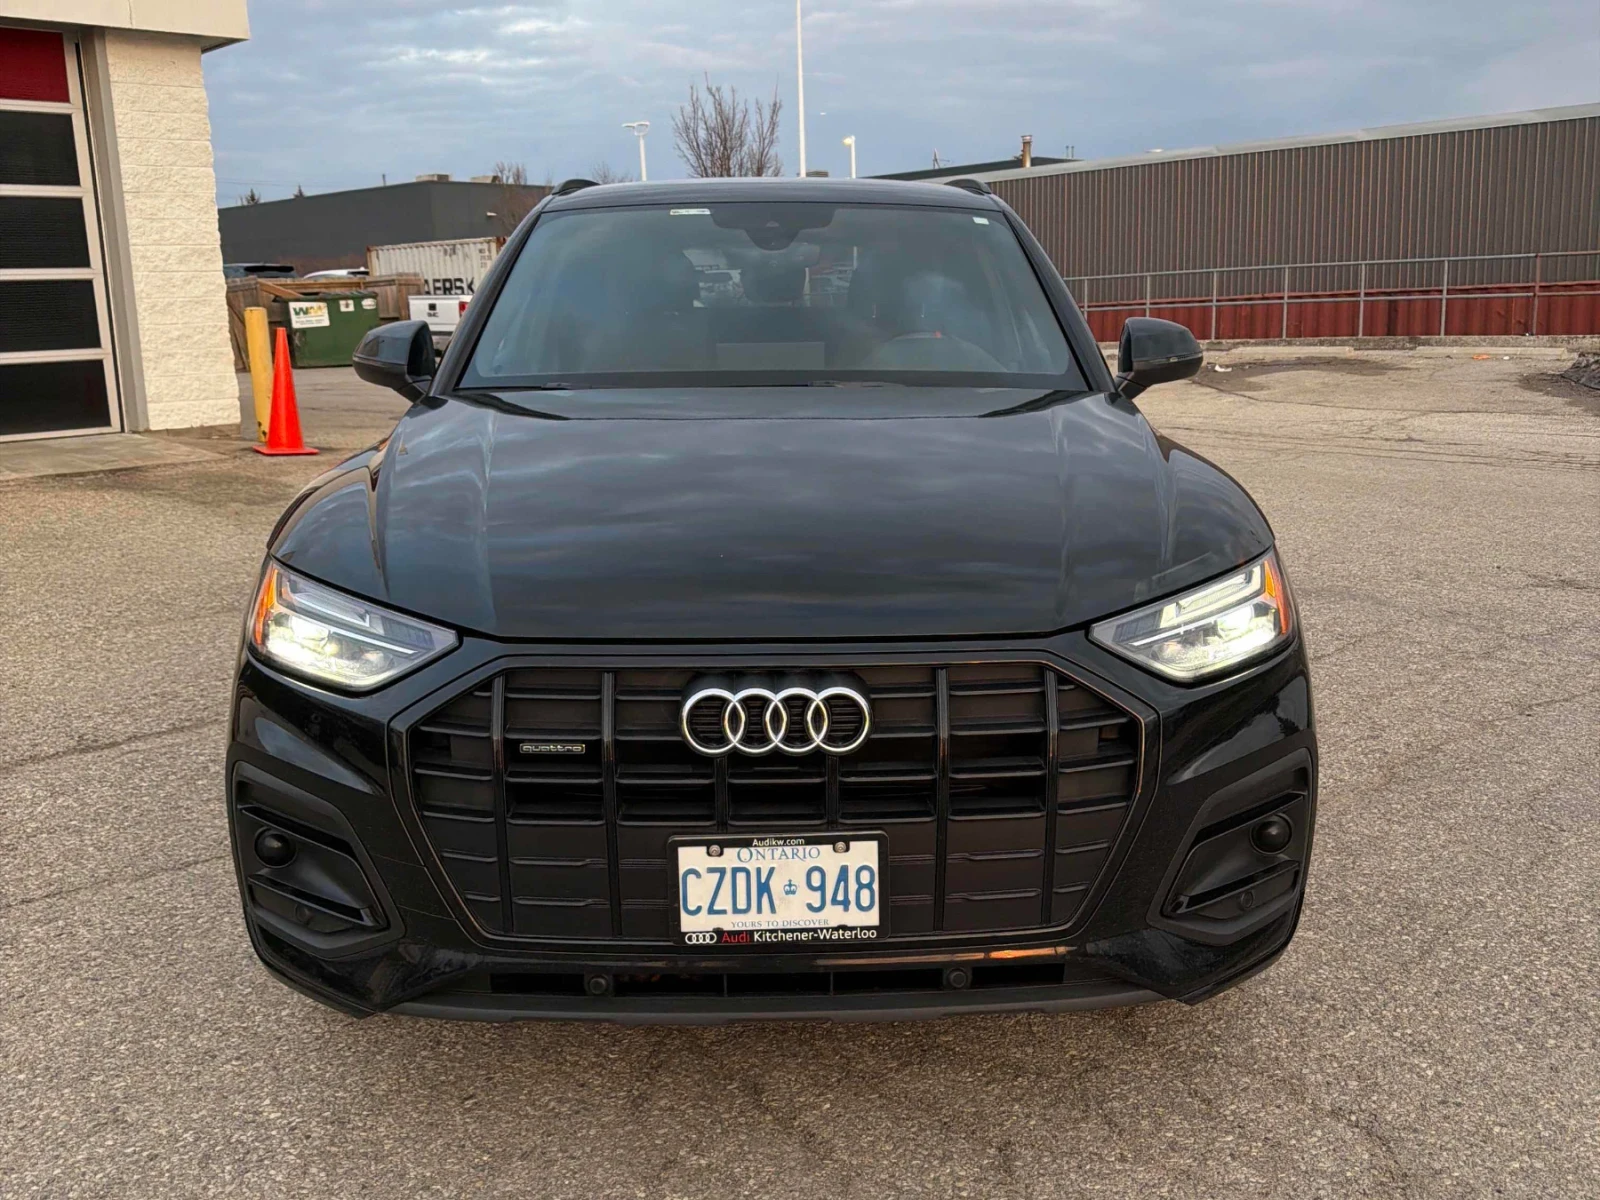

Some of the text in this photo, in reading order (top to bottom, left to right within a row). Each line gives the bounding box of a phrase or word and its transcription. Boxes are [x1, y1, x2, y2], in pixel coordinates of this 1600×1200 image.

[522, 745, 582, 753] quattro
[752, 837, 805, 847] Audikw.com
[737, 846, 821, 863] ONTARIO
[681, 864, 876, 916] CZDK 948
[731, 918, 830, 929] YOURS TO DISCOVER
[721, 928, 877, 944] Audi Kitchener-Waterloo
